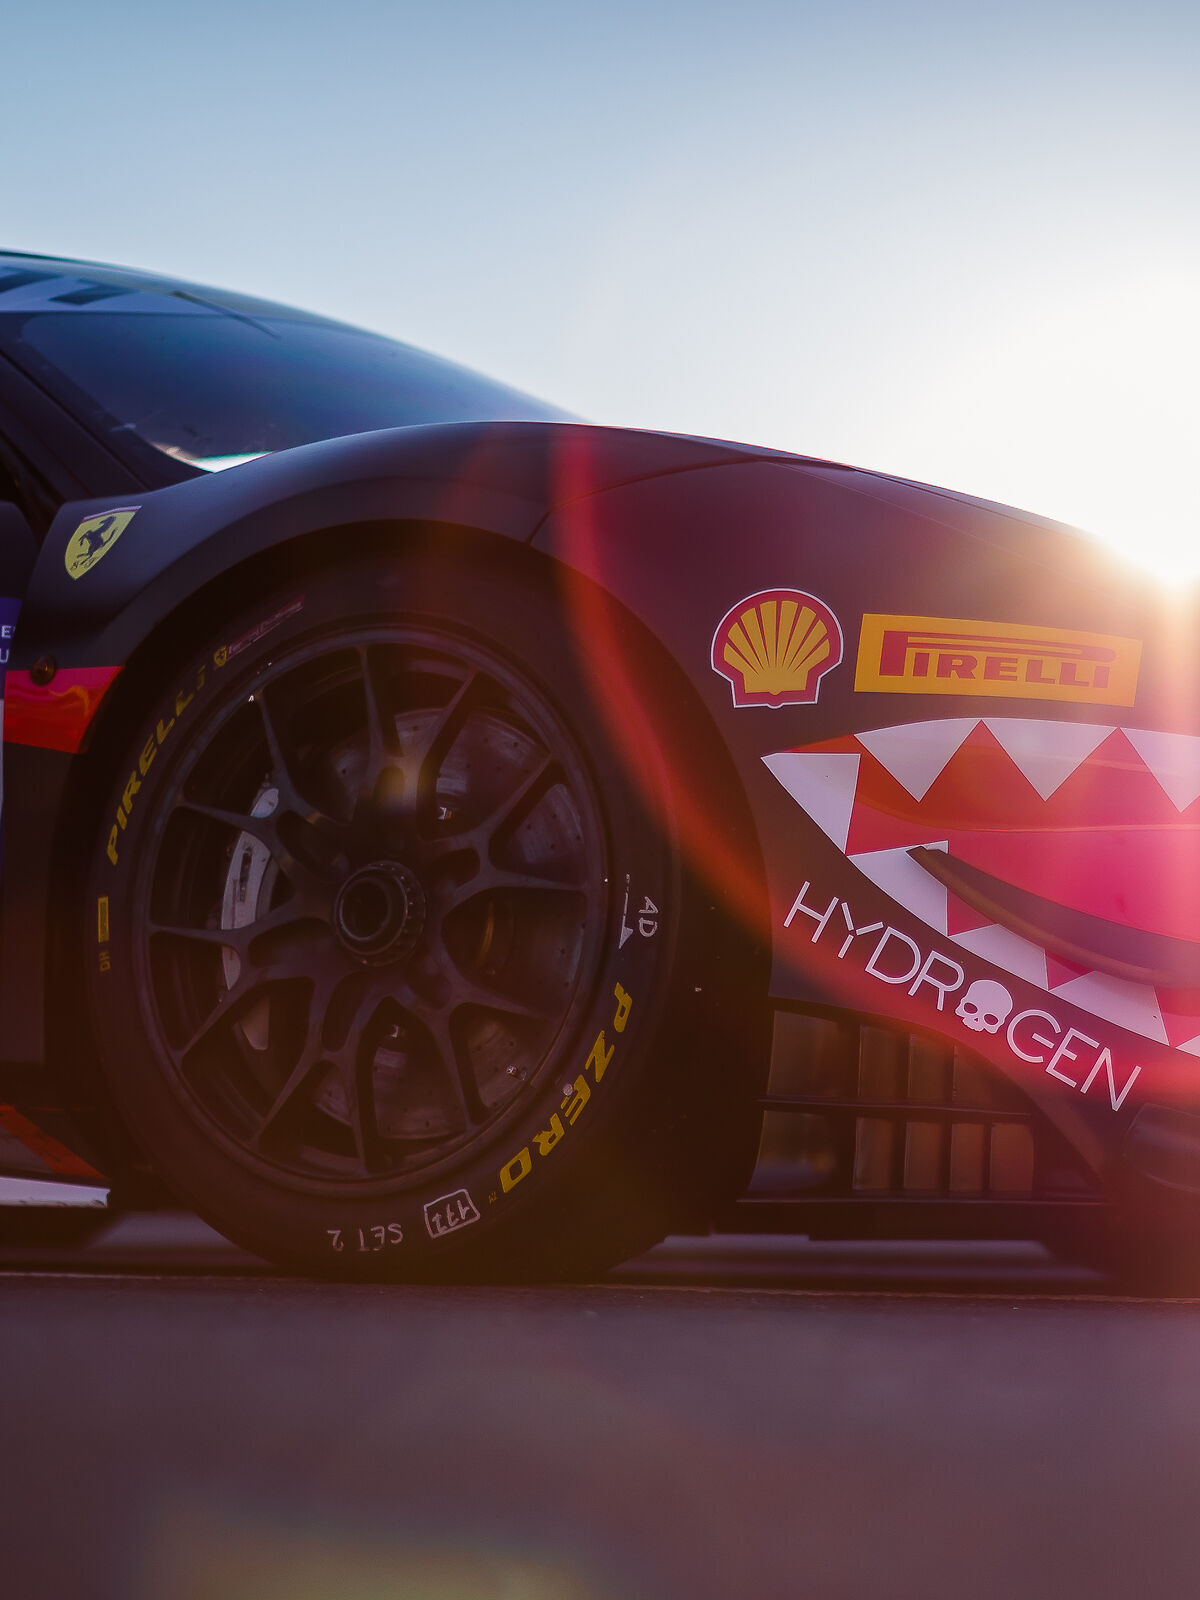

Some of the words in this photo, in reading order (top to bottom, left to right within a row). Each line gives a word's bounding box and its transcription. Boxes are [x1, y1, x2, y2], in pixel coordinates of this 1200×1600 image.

[878, 630, 1117, 690] PIRELLI
[107, 664, 207, 866] PIRELLI
[327, 1229, 345, 1252] 2
[357, 1223, 403, 1251] SET
